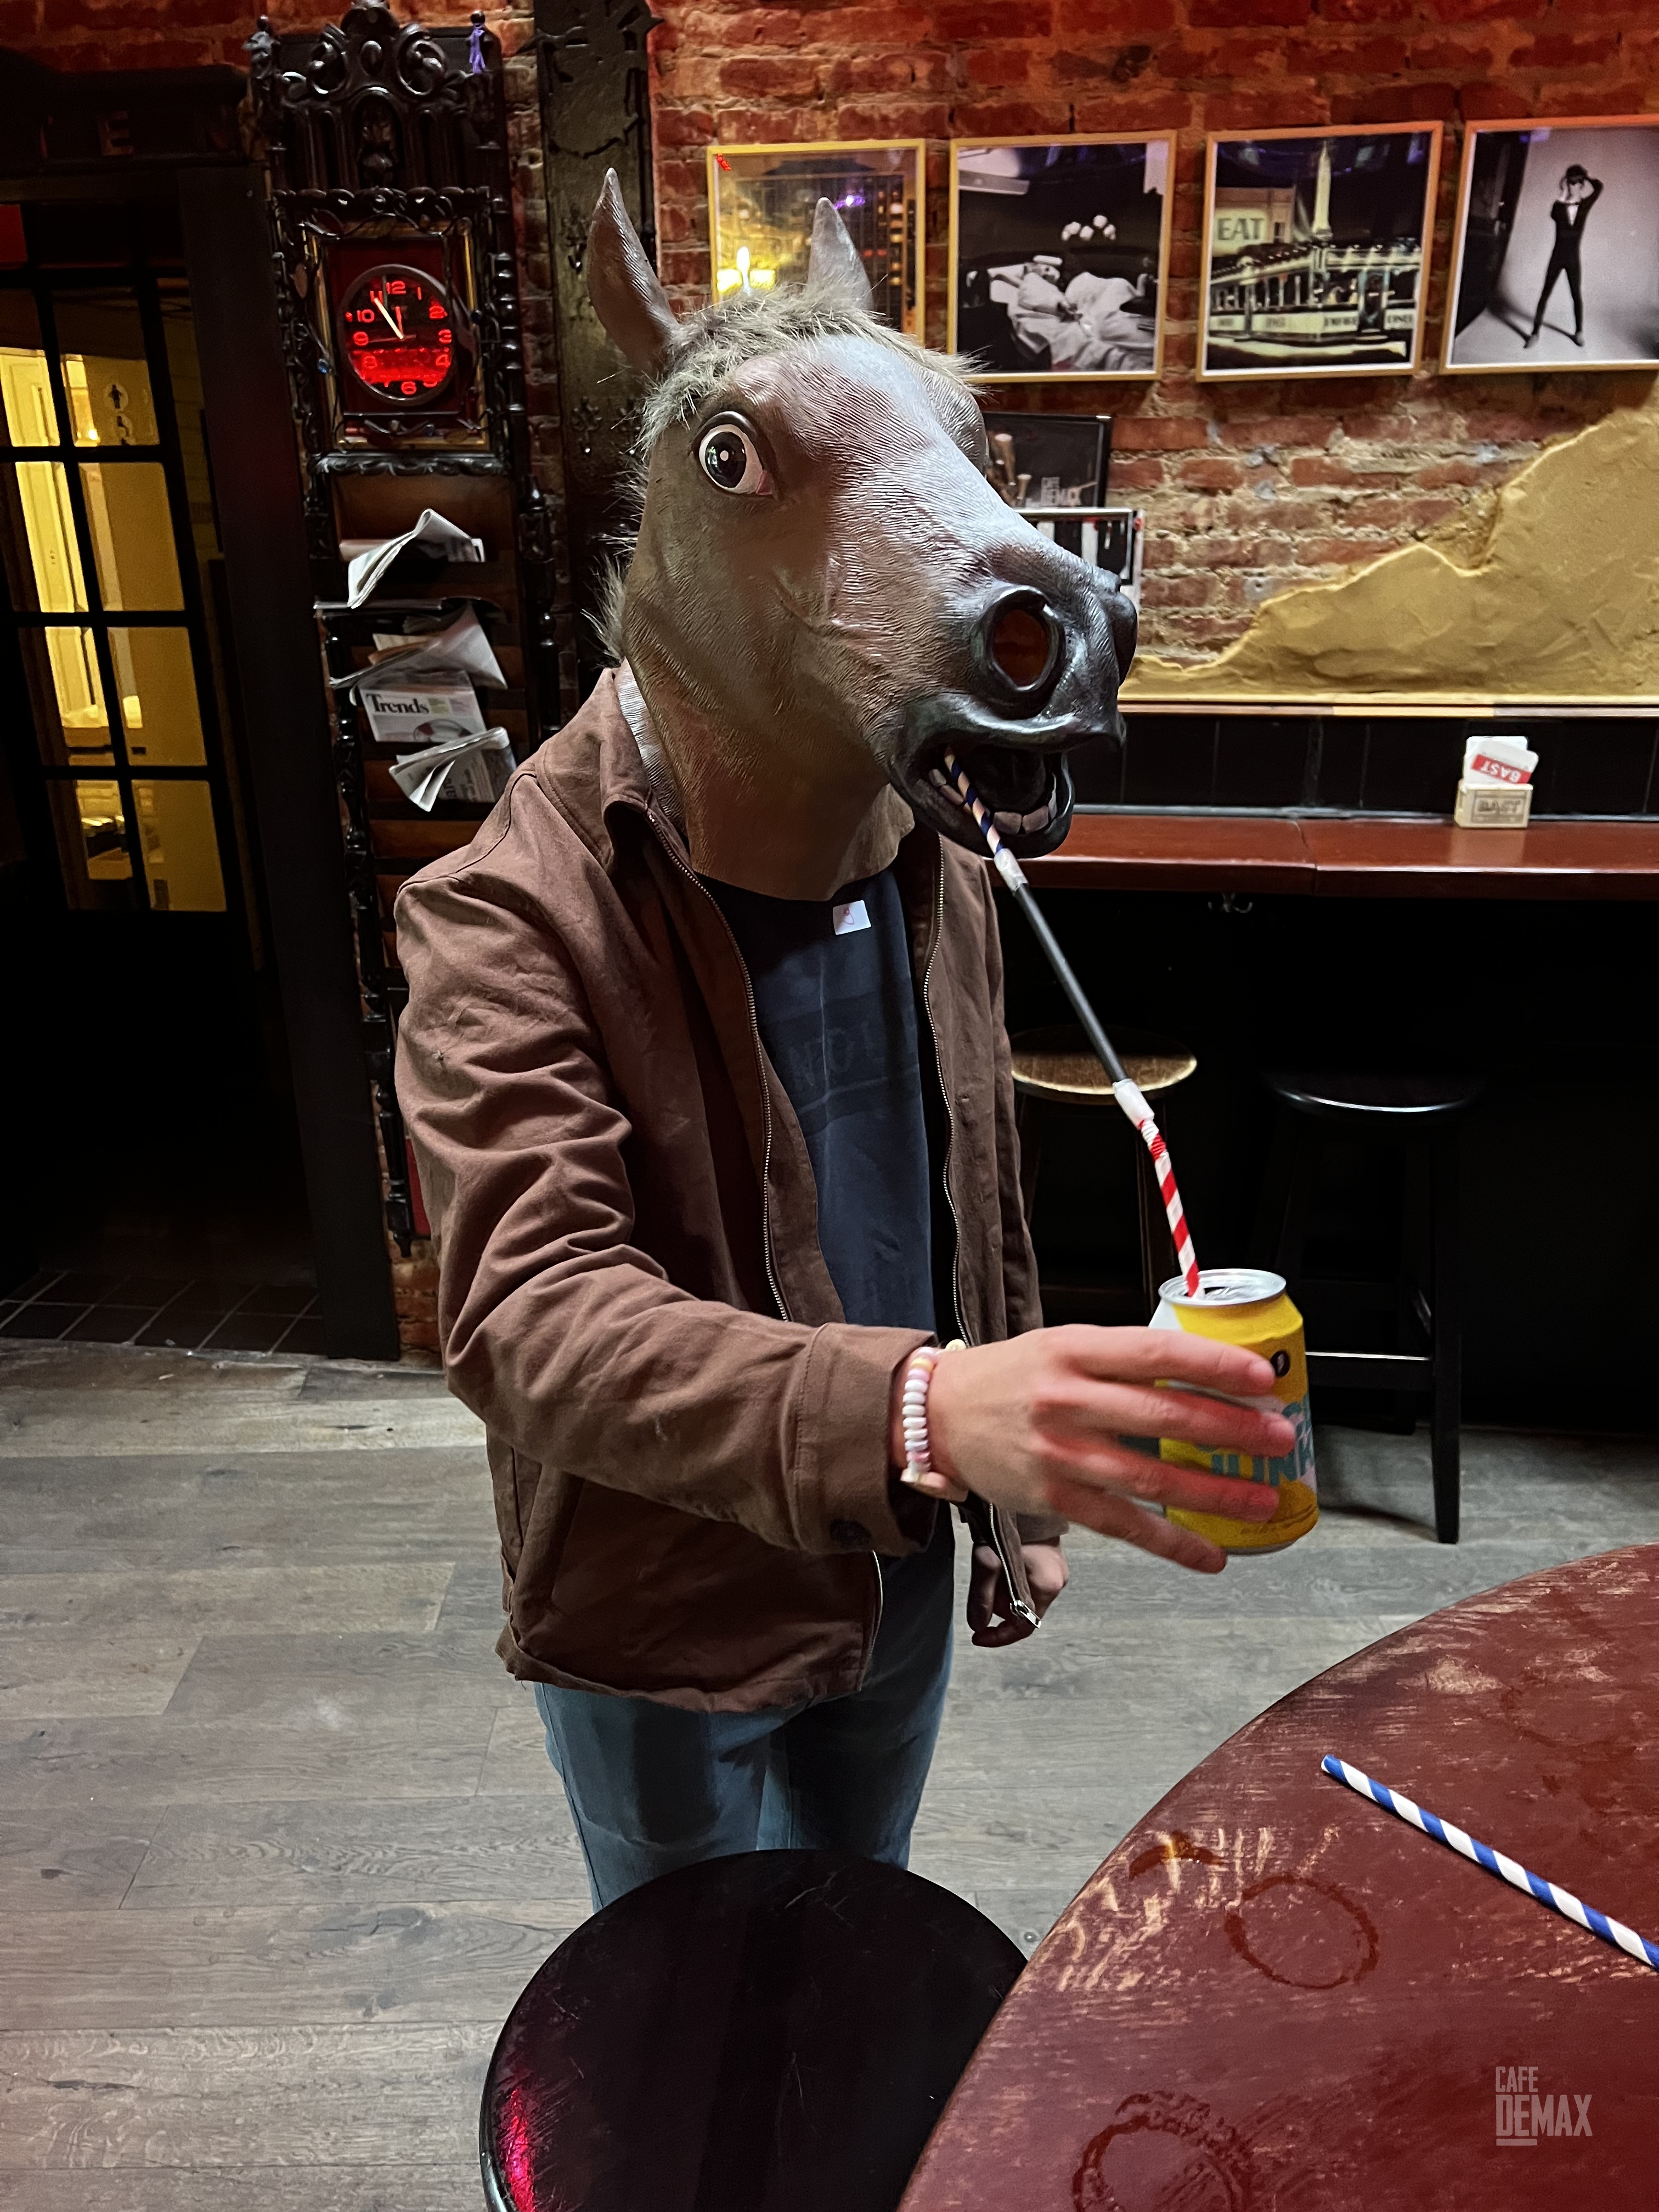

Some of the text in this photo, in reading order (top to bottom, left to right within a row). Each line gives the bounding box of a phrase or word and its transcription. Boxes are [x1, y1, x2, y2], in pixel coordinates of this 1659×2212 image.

[1217, 217, 1265, 240] EAT
[386, 280, 406, 295] 12
[357, 308, 375, 323] 10
[429, 305, 445, 319] 2
[353, 331, 369, 346] 9
[438, 329, 452, 343] 3
[364, 355, 377, 369] 8
[436, 354, 450, 368] 4
[400, 381, 417, 395] 6
[366, 693, 430, 714] Trends
